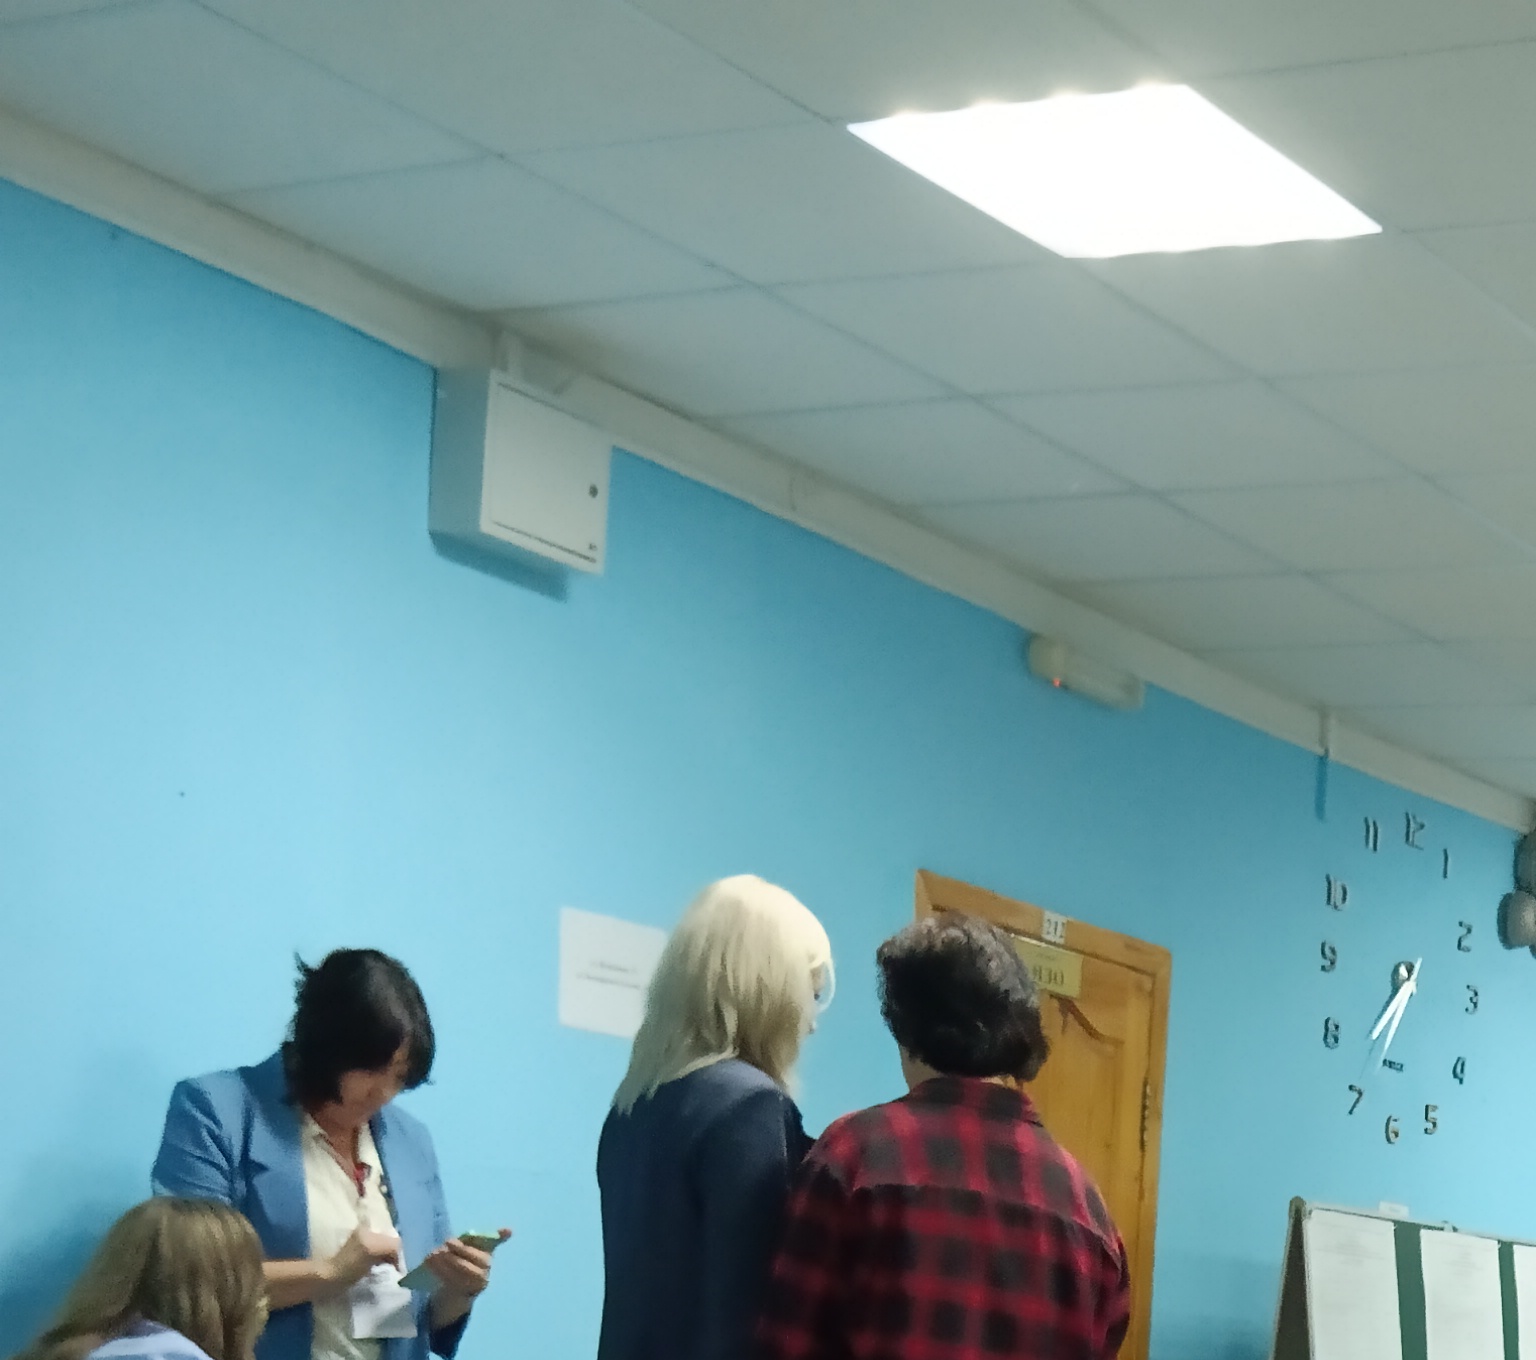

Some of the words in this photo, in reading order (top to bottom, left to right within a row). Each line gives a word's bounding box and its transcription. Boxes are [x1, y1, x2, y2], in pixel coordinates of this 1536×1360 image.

[1457, 920, 1473, 952] 2
[1320, 940, 1337, 973] 9
[1465, 984, 1479, 1015] 3
[1323, 1016, 1340, 1050] 8
[1452, 1056, 1466, 1085] 4
[1348, 1084, 1363, 1116] 7
[1385, 1115, 1400, 1145] 6
[1424, 1104, 1439, 1135] 5
